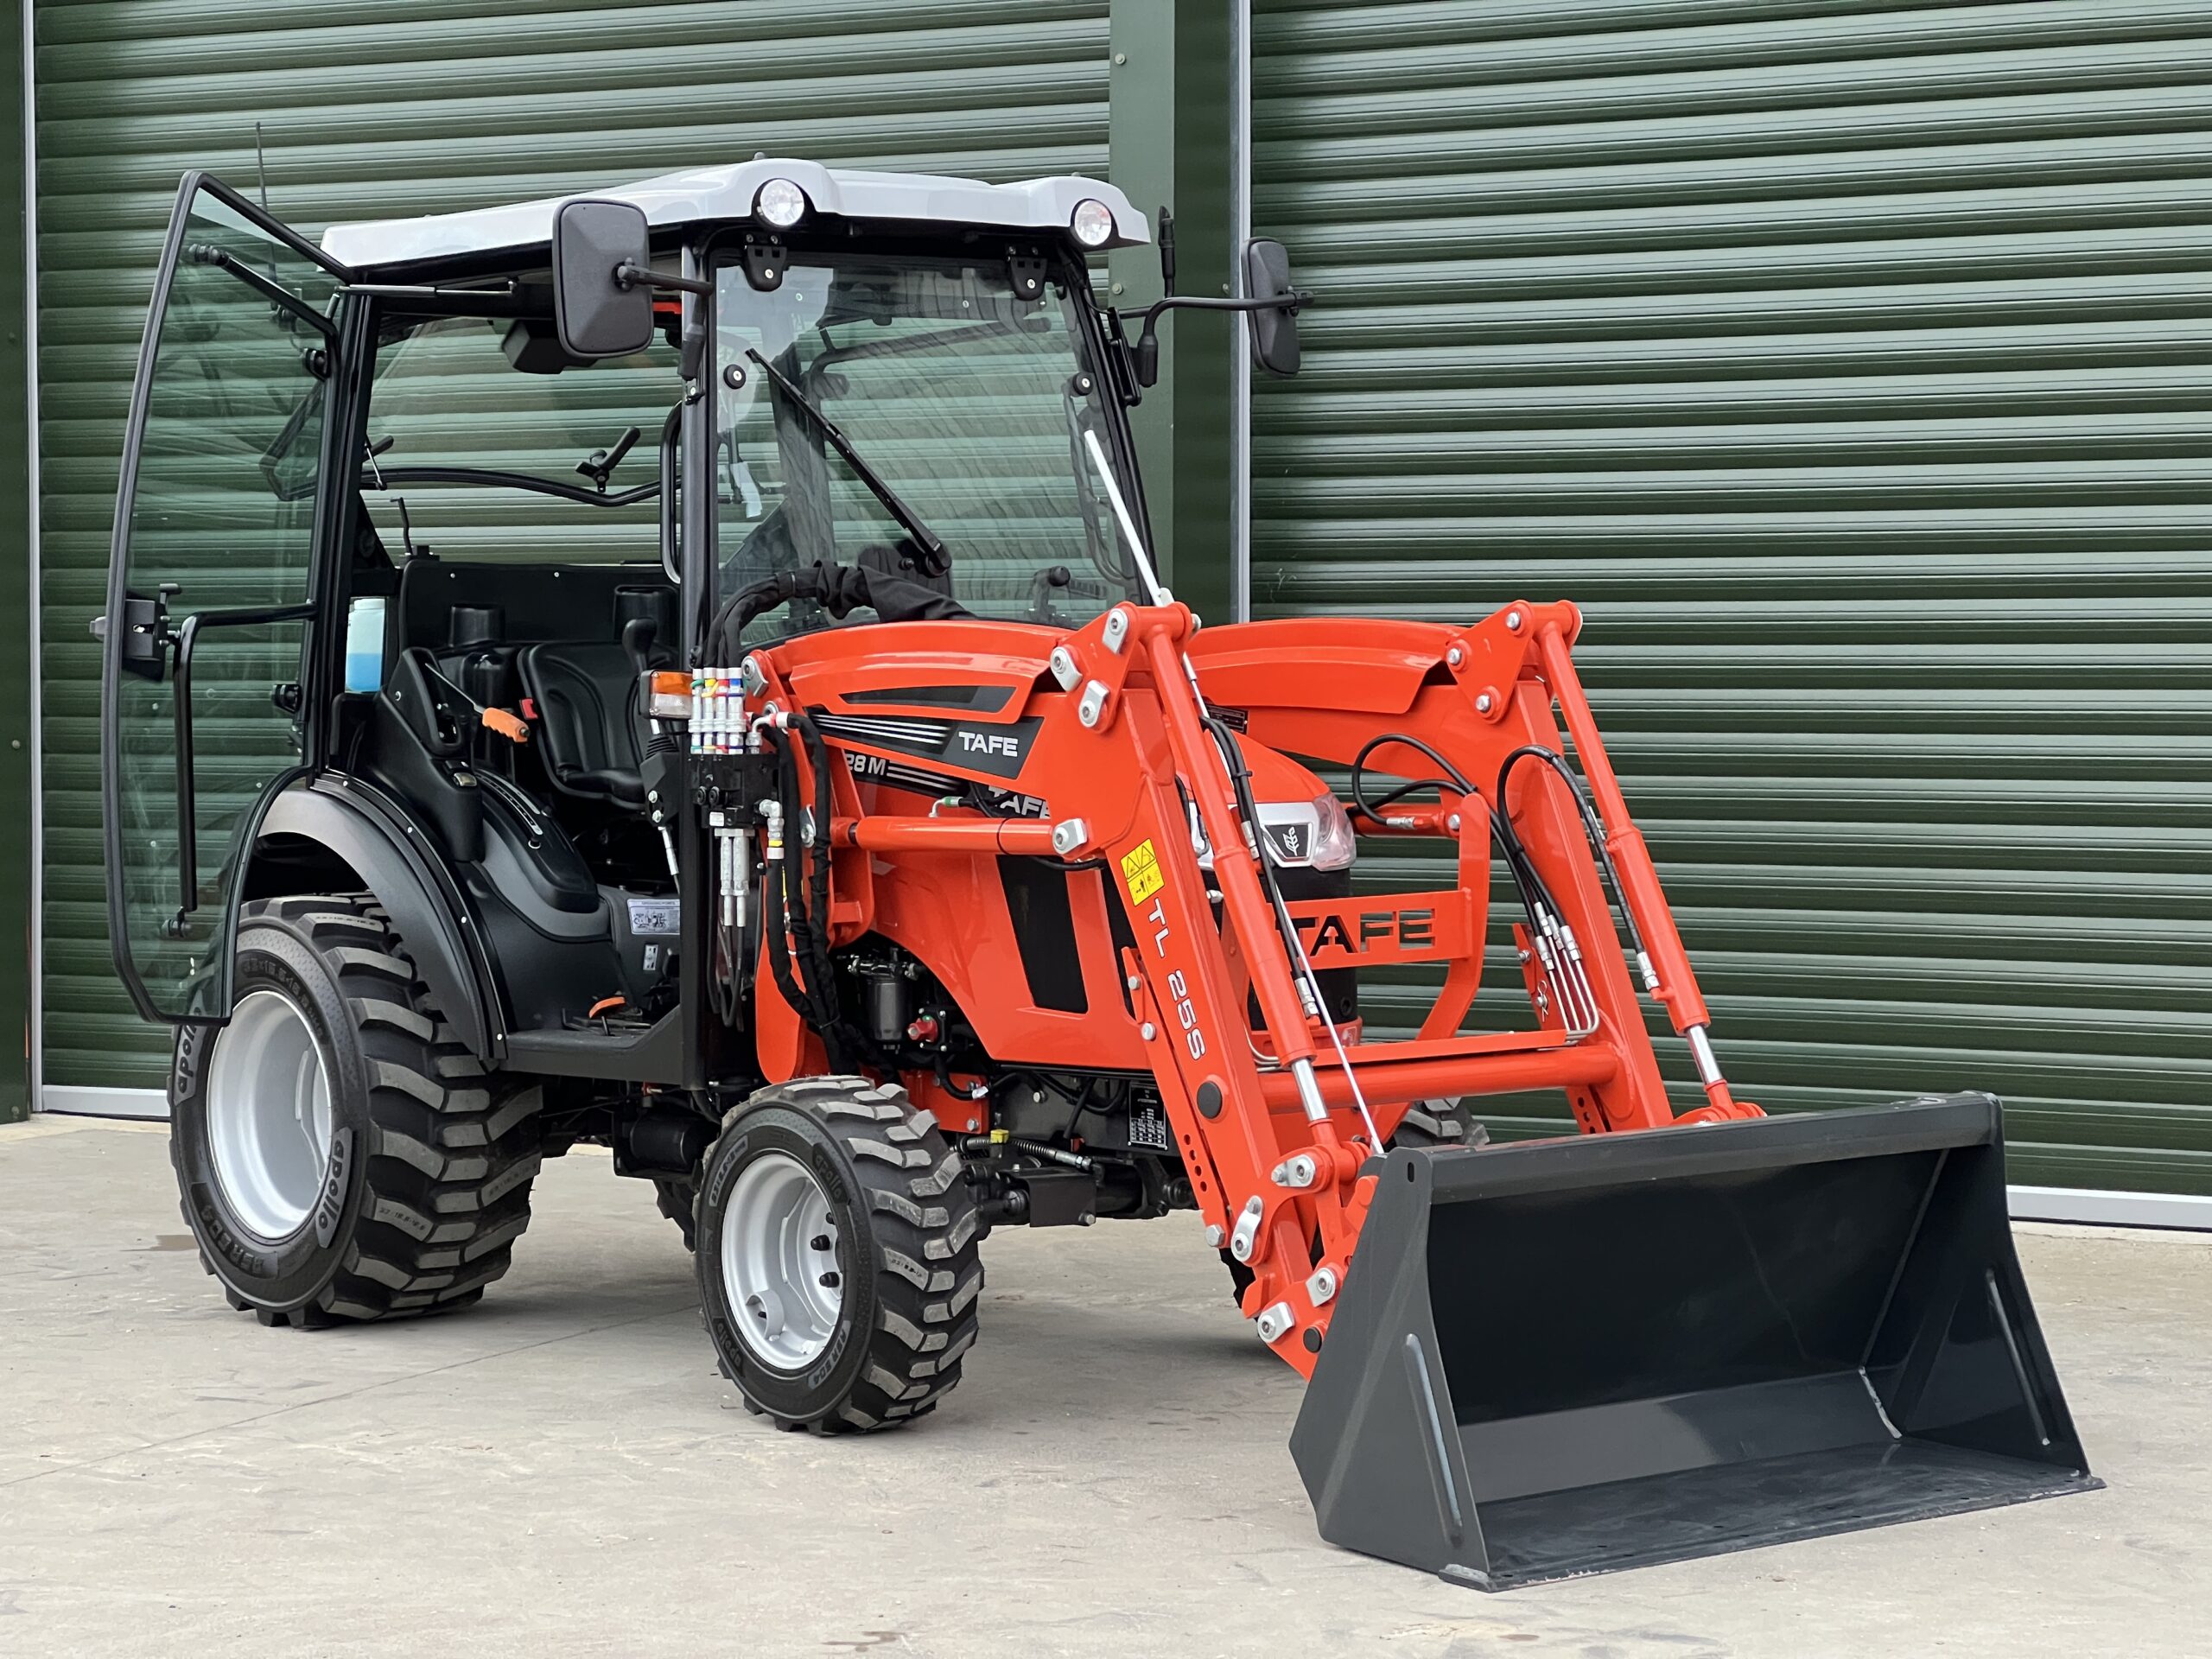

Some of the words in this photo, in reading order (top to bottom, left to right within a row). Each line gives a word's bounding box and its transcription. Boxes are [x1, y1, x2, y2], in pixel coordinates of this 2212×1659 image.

[868, 756, 887, 776] M
[958, 731, 1018, 757] TAFE
[1147, 897, 1170, 959] TL
[1167, 969, 1207, 1061] 25S
[318, 1139, 345, 1230] apollo
[815, 1154, 843, 1199] apollo
[716, 1323, 743, 1366] apollo
